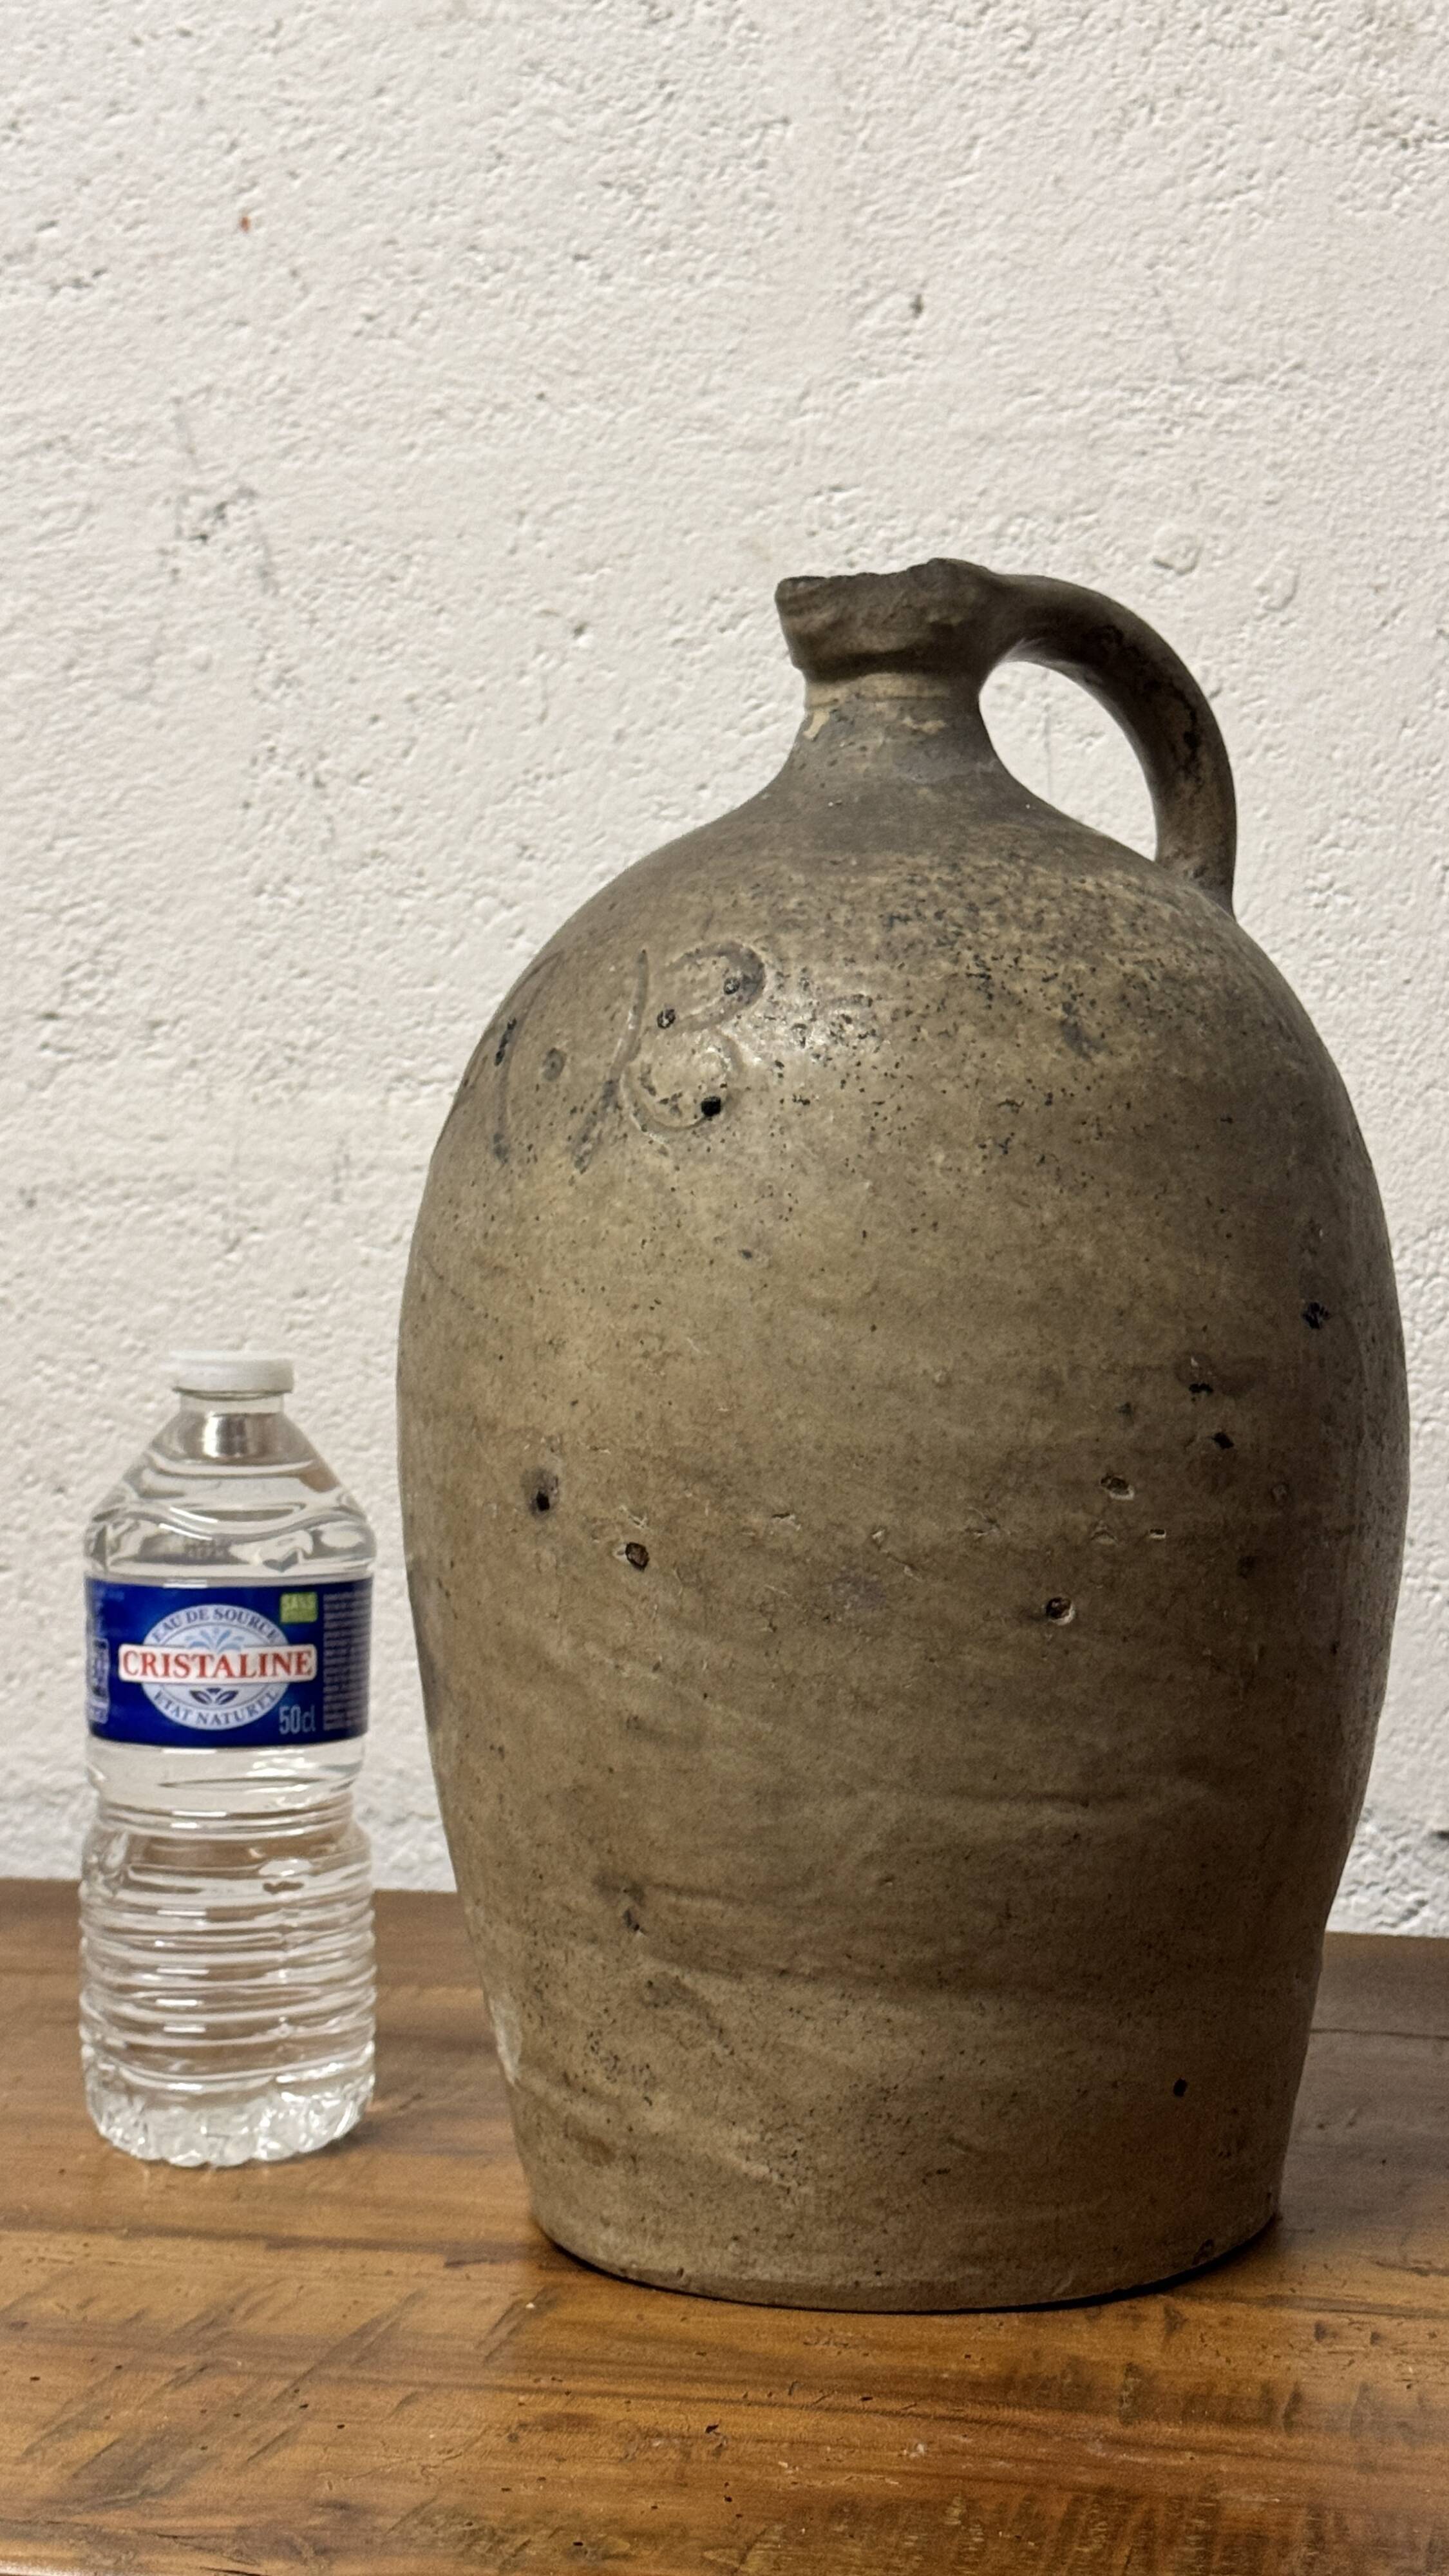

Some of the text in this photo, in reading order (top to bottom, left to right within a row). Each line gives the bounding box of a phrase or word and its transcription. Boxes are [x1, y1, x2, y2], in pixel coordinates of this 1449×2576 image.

[152, 1607, 281, 1642] EAU DE SOURCE
[122, 1650, 312, 1679] CRISTALINE
[154, 1690, 280, 1726] ETAT NATUREL
[279, 1705, 316, 1735] 50cl
